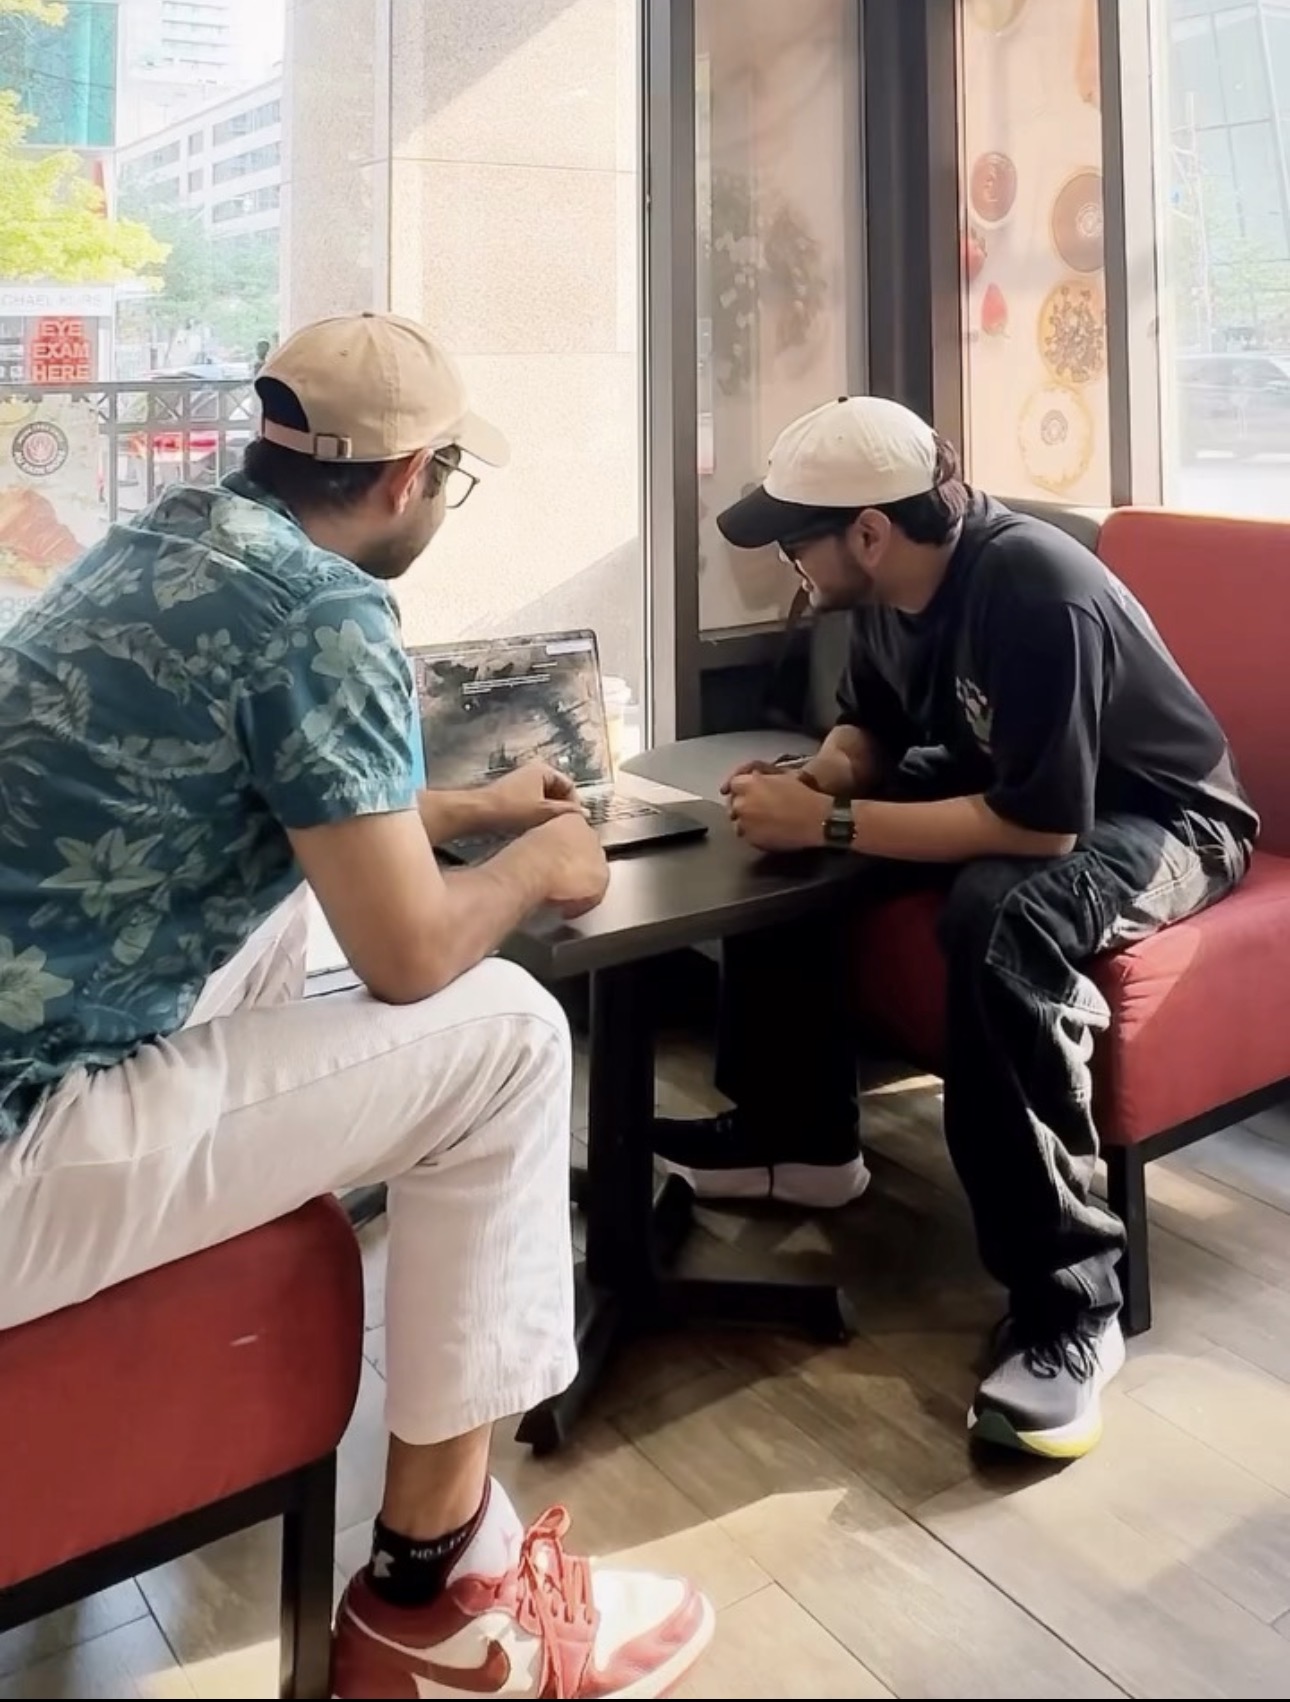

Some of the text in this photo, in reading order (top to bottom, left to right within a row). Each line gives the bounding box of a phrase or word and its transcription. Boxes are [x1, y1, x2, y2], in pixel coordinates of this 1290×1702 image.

[40, 321, 83, 337] EYE
[33, 342, 91, 358] EXAM
[33, 363, 89, 381] HERE
